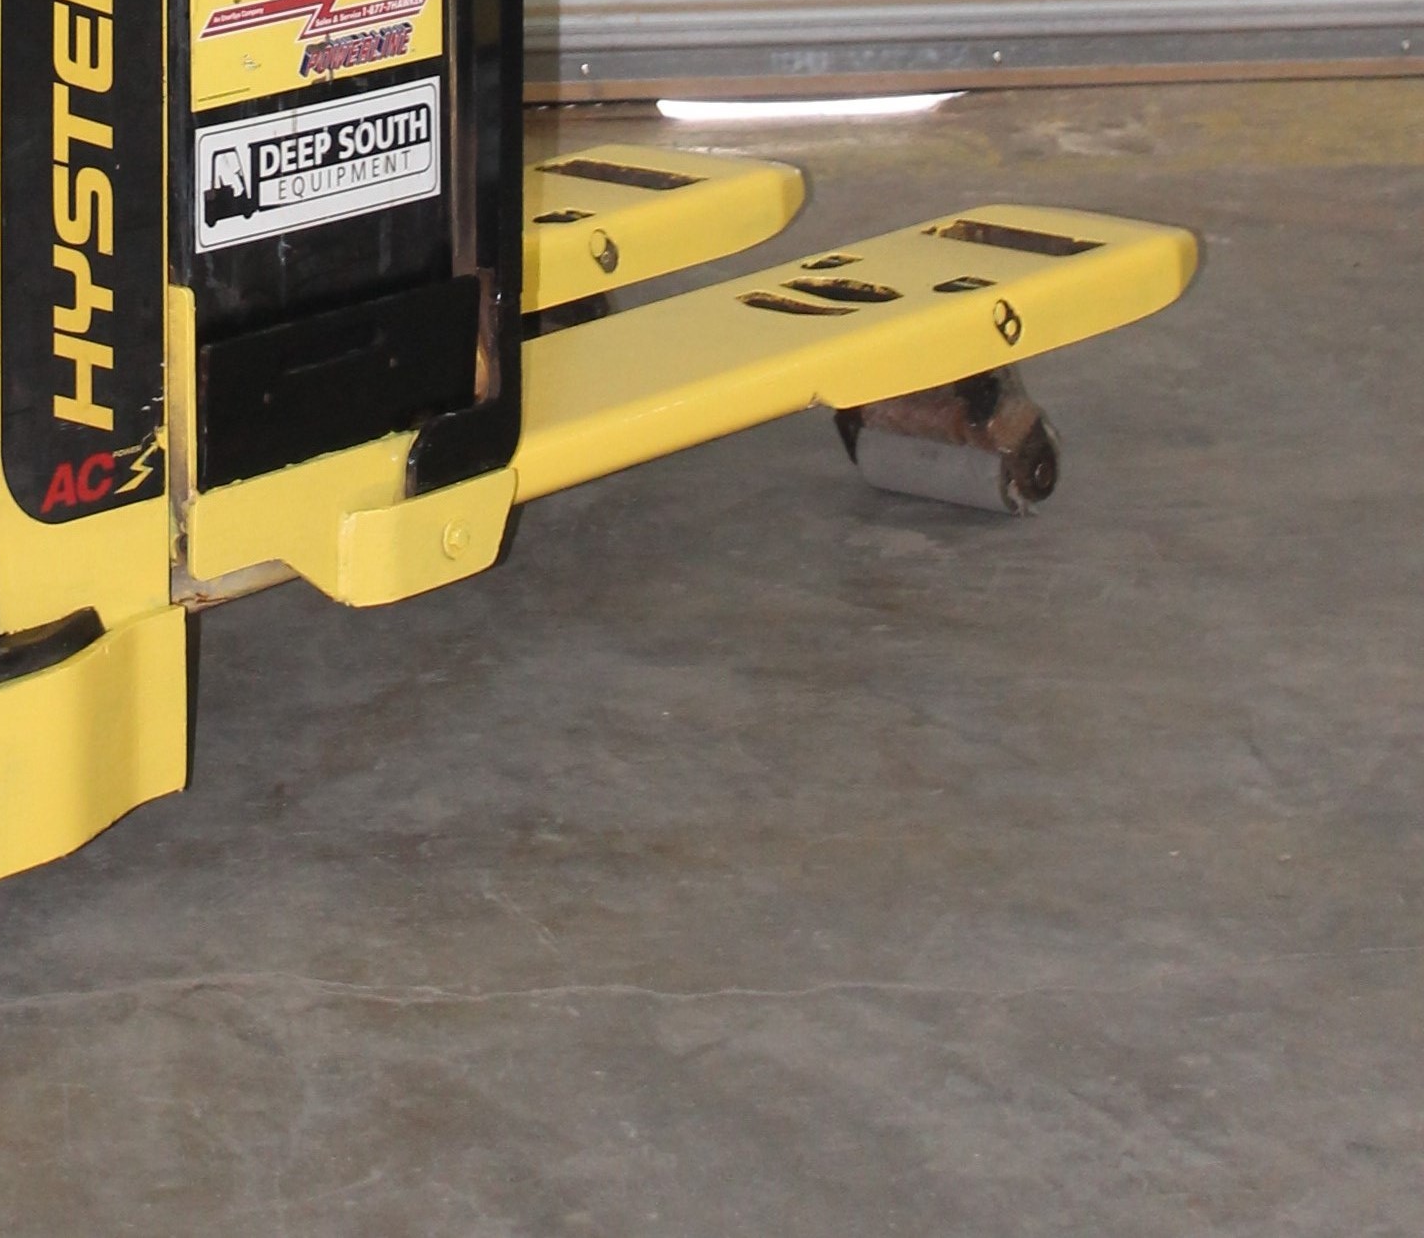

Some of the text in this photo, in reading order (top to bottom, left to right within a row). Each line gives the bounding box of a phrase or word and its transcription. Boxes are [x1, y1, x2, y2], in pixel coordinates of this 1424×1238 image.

[300, 23, 412, 77] POWERLINE
[259, 107, 427, 178] DEEP SOUTH
[279, 149, 411, 200] EQUIPMENT
[40, 452, 115, 514] AC
